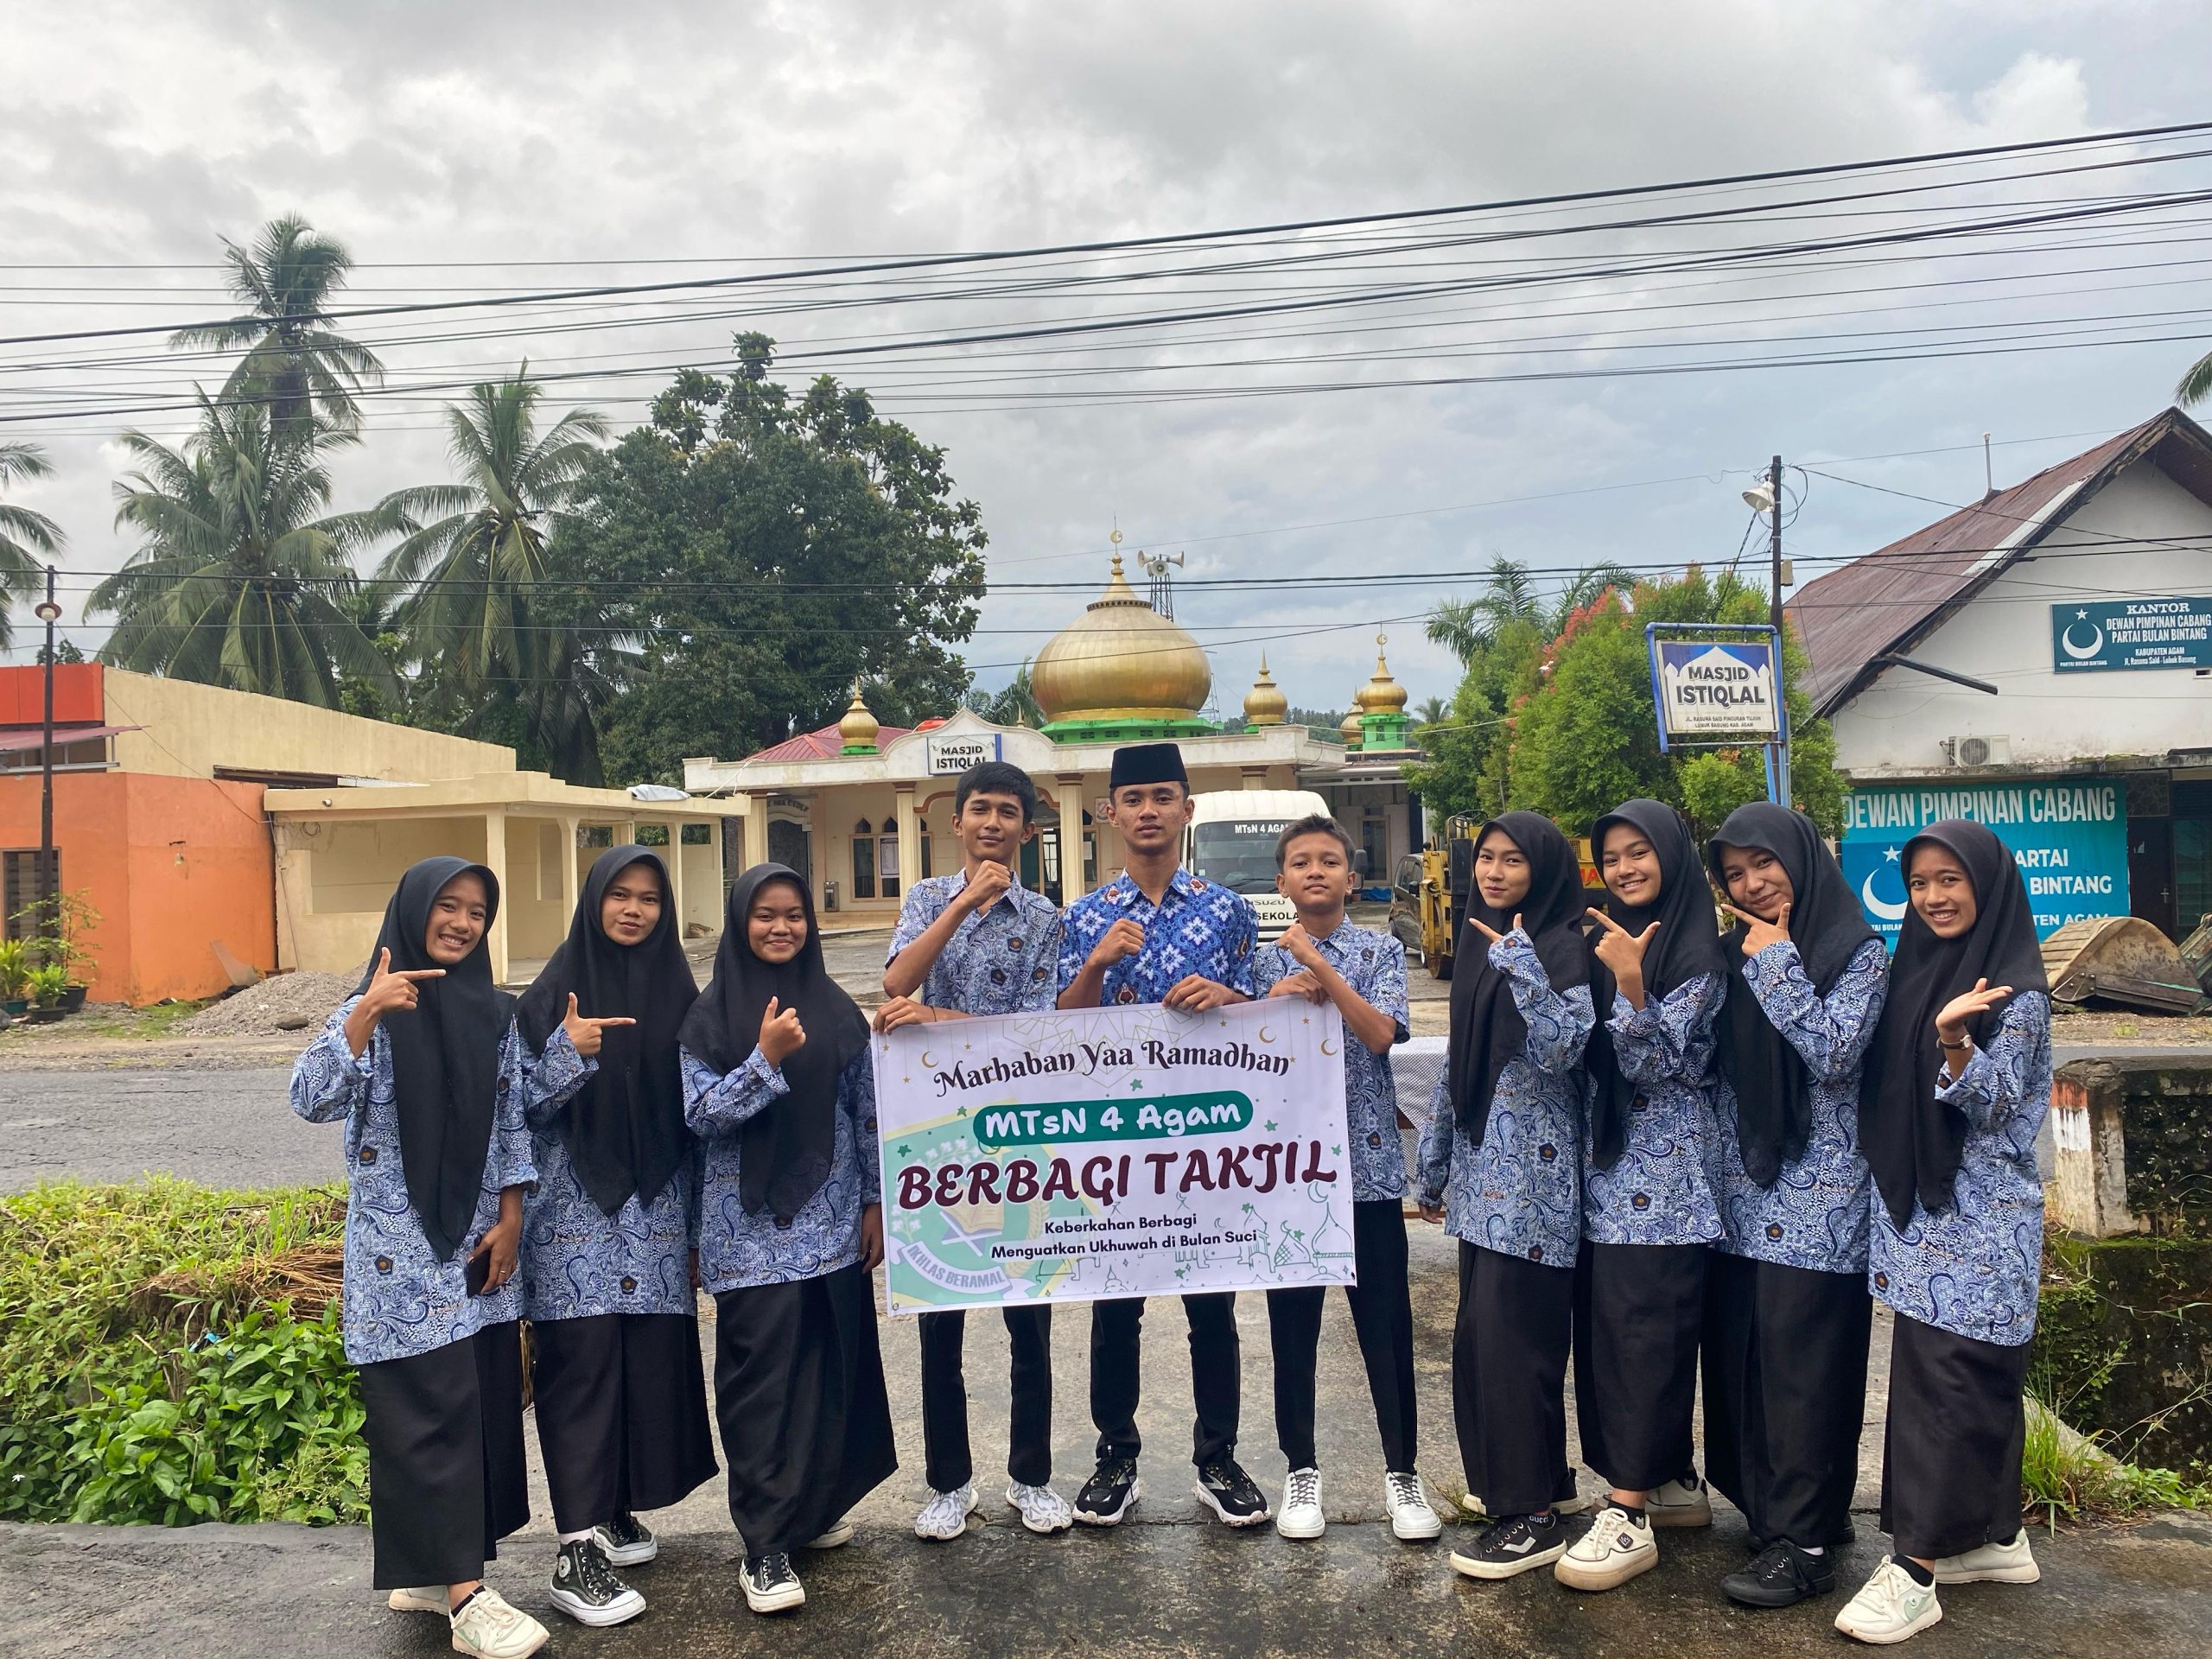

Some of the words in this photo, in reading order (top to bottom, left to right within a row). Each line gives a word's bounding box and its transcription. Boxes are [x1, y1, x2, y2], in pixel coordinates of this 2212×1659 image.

[2126, 602, 2190, 615] KANTOR
[2106, 617, 2135, 631] DEWAN
[2136, 614, 2176, 629] PIMPINAN
[2177, 613, 2212, 628] CABANG
[2112, 630, 2140, 644] PARTAI
[2142, 629, 2170, 642] BULAN
[2171, 627, 2208, 641] BINTANG
[2135, 647, 2167, 657] KABUPATEN
[2168, 646, 2185, 655] AGAM
[1688, 666, 1750, 682] MASJID
[1676, 685, 1766, 709] ISTIQLAL
[941, 746, 982, 755] MASJID
[1841, 793, 1915, 829] DEWAN
[1921, 790, 2023, 826] PIMPINAN
[2031, 787, 2116, 822] CABANG
[1235, 823, 1258, 834] MTsN
[1260, 823, 1266, 833] 4
[2015, 849, 2069, 868] ARTAI
[2030, 875, 2113, 895] BINTANG
[1257, 912, 1299, 920] SEKOLA
[934, 1051, 1077, 1097] Marhaban
[1080, 1041, 1134, 1077] Yaa
[1141, 1039, 1290, 1077] Ramadhan
[985, 1107, 1087, 1139] MTsN
[1099, 1106, 1124, 1132] 4
[1136, 1103, 1242, 1136] Agam
[897, 1154, 1131, 1211] BERBAGI
[1144, 1140, 1338, 1194] TAKJIL
[1045, 1220, 1135, 1235] Keberkahan
[1139, 1213, 1198, 1230] Berbagi
[991, 1243, 1086, 1260] Menguatkan
[1090, 1238, 1158, 1253] Ukhuwah
[1161, 1236, 1176, 1248] di
[1180, 1231, 1221, 1247] Bulan
[1224, 1230, 1257, 1243] Suci
[906, 1245, 946, 1281] IKHLAS
[945, 1270, 1006, 1288] BERAMAL
